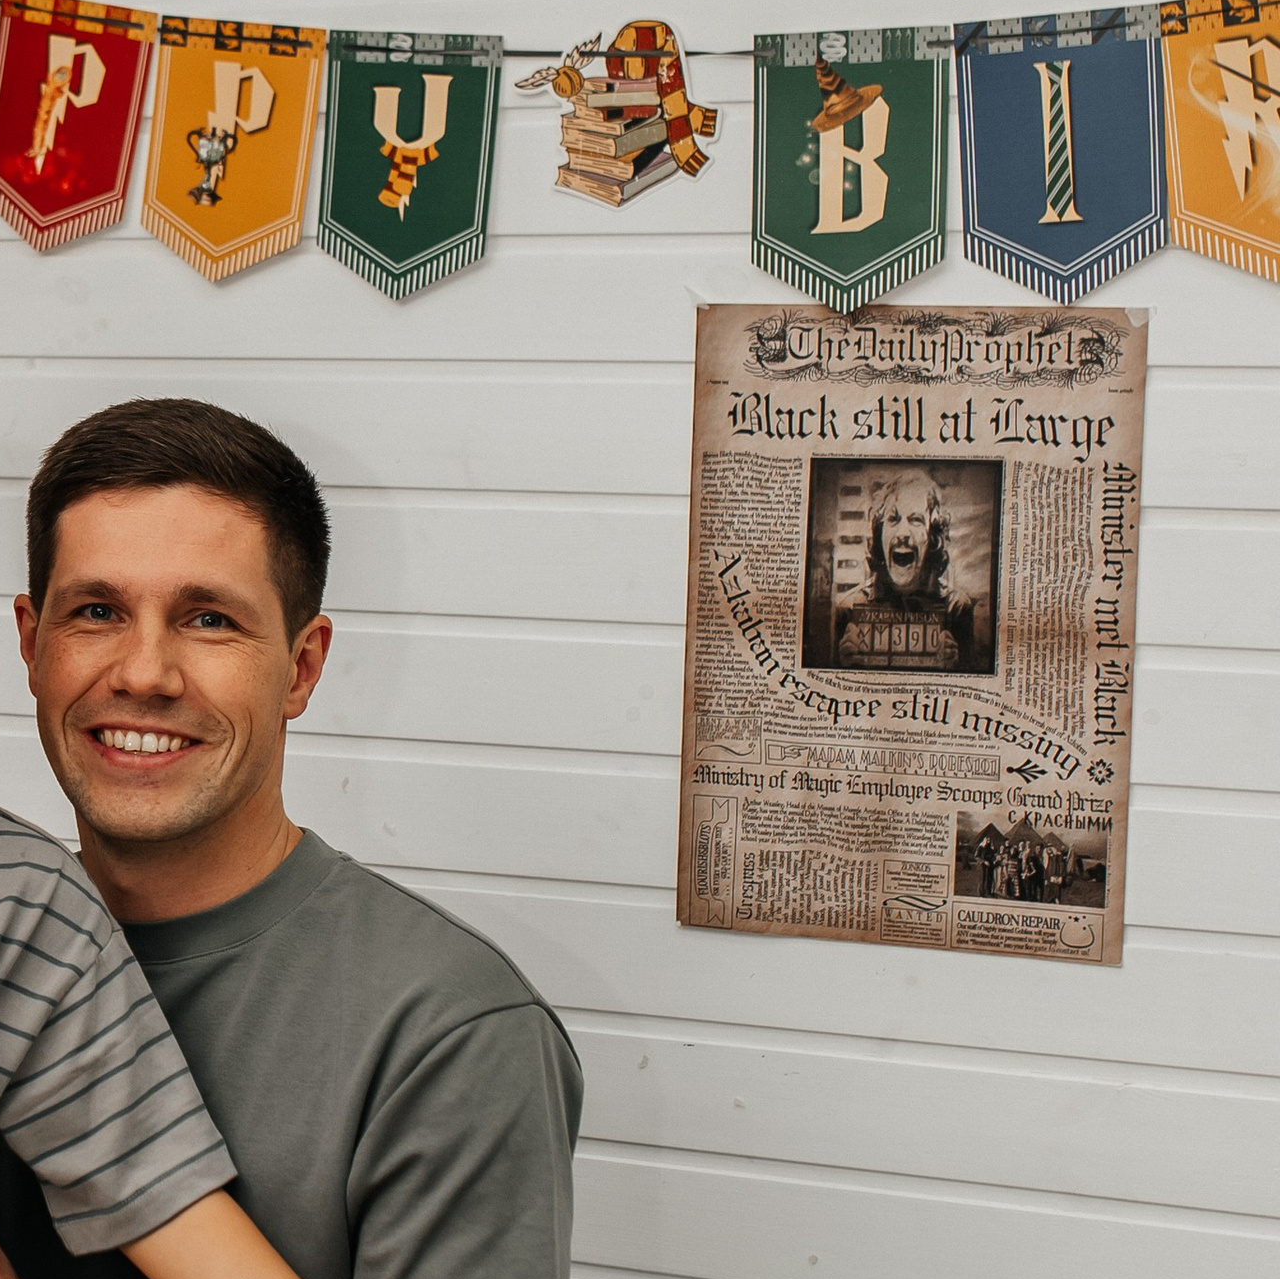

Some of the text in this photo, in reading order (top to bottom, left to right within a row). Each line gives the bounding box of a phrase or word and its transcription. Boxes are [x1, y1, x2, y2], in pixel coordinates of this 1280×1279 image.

[787, 325, 1077, 375] The Daily Prophet
[727, 391, 1116, 463] Black still at Large
[1092, 460, 1138, 747] Minister met Black
[713, 548, 1082, 781] Azkaban escapee still missing
[806, 745, 856, 765] MADAM
[860, 748, 925, 770] MALKIN'S
[692, 764, 765, 793] Ministry
[768, 769, 789, 789] of
[791, 769, 842, 798] Magic
[846, 774, 933, 805] Employee
[935, 780, 1003, 810] Scoops
[1006, 786, 1063, 810] Grand
[1066, 788, 1115, 817] Prize
[1022, 810, 1114, 833] КРАСНЫМИ
[735, 852, 760, 920] Trespass
[884, 908, 943, 923] WANTED
[957, 909, 1061, 930] CAULDRON REPAIR
